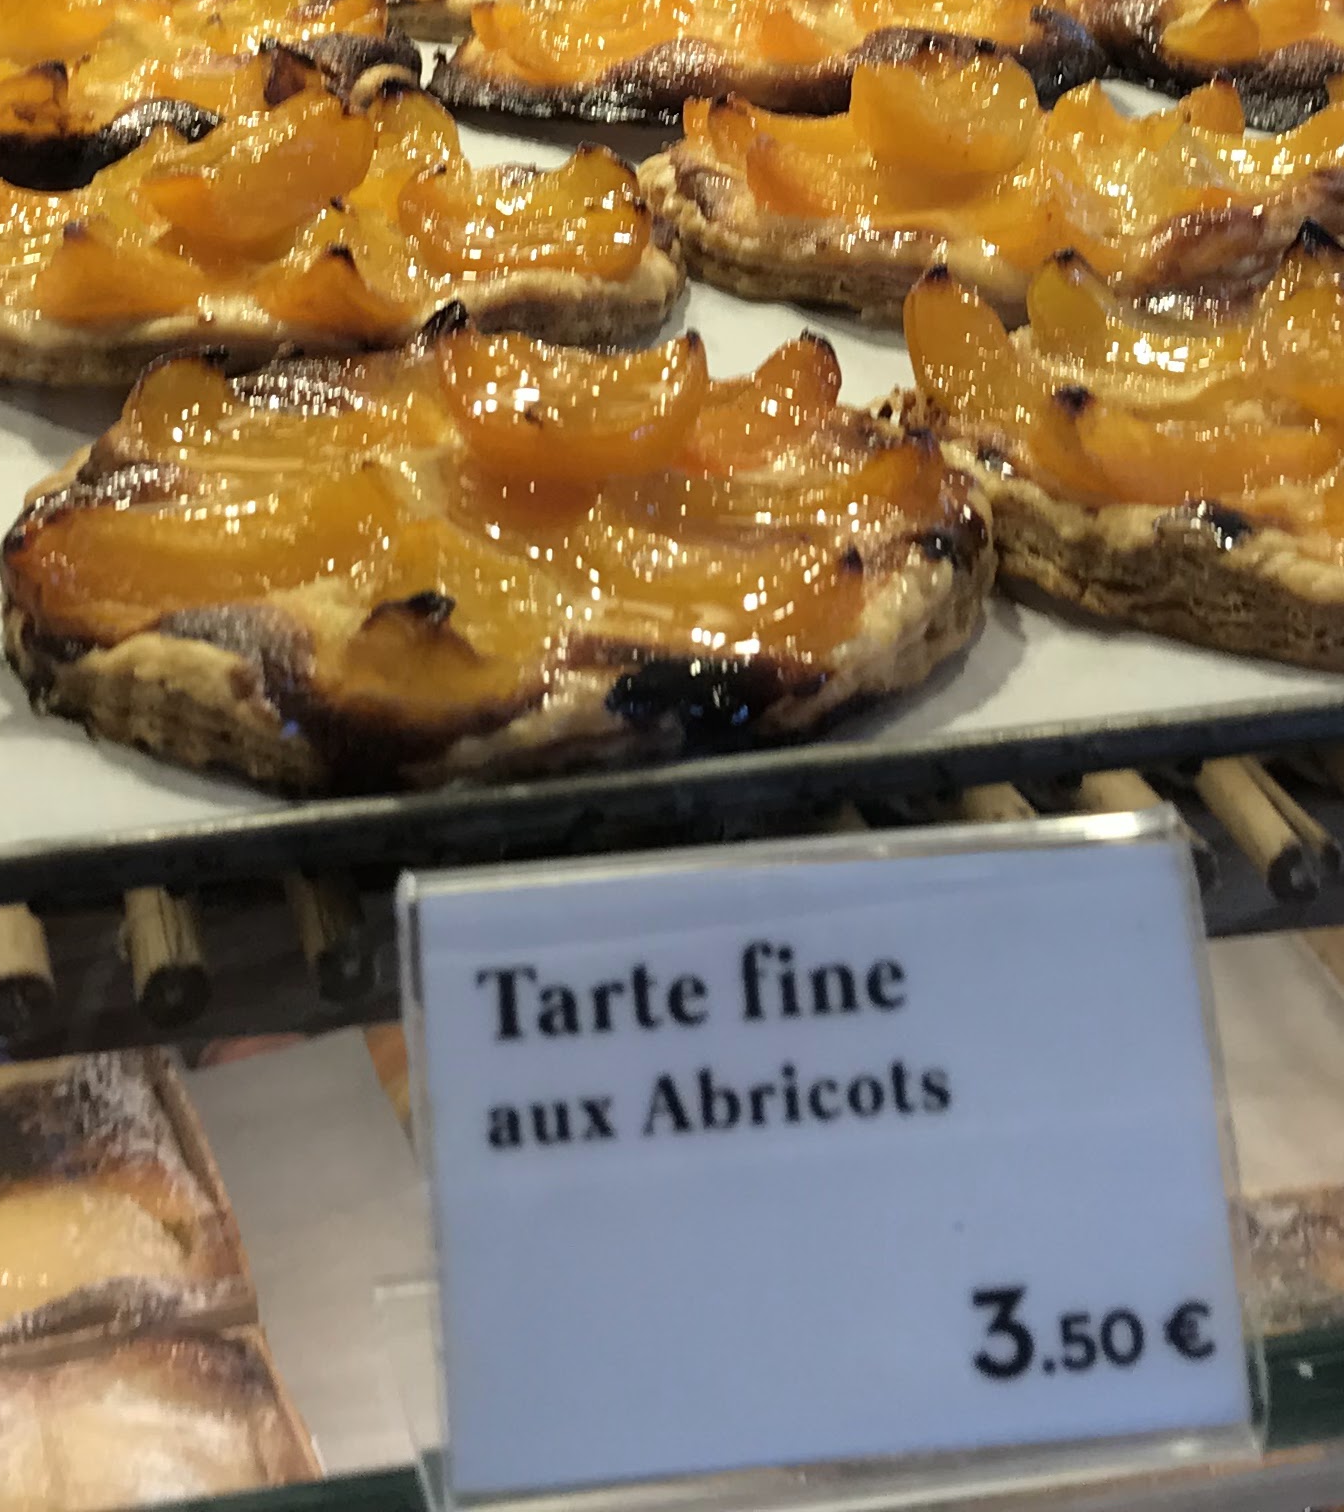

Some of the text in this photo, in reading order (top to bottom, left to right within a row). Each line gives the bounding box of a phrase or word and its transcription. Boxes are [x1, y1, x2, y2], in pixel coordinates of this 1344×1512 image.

[476, 940, 908, 1043] Tarte fine
[487, 1060, 953, 1151] aux Abricots
[970, 1285, 1217, 1382] 3.50 €
